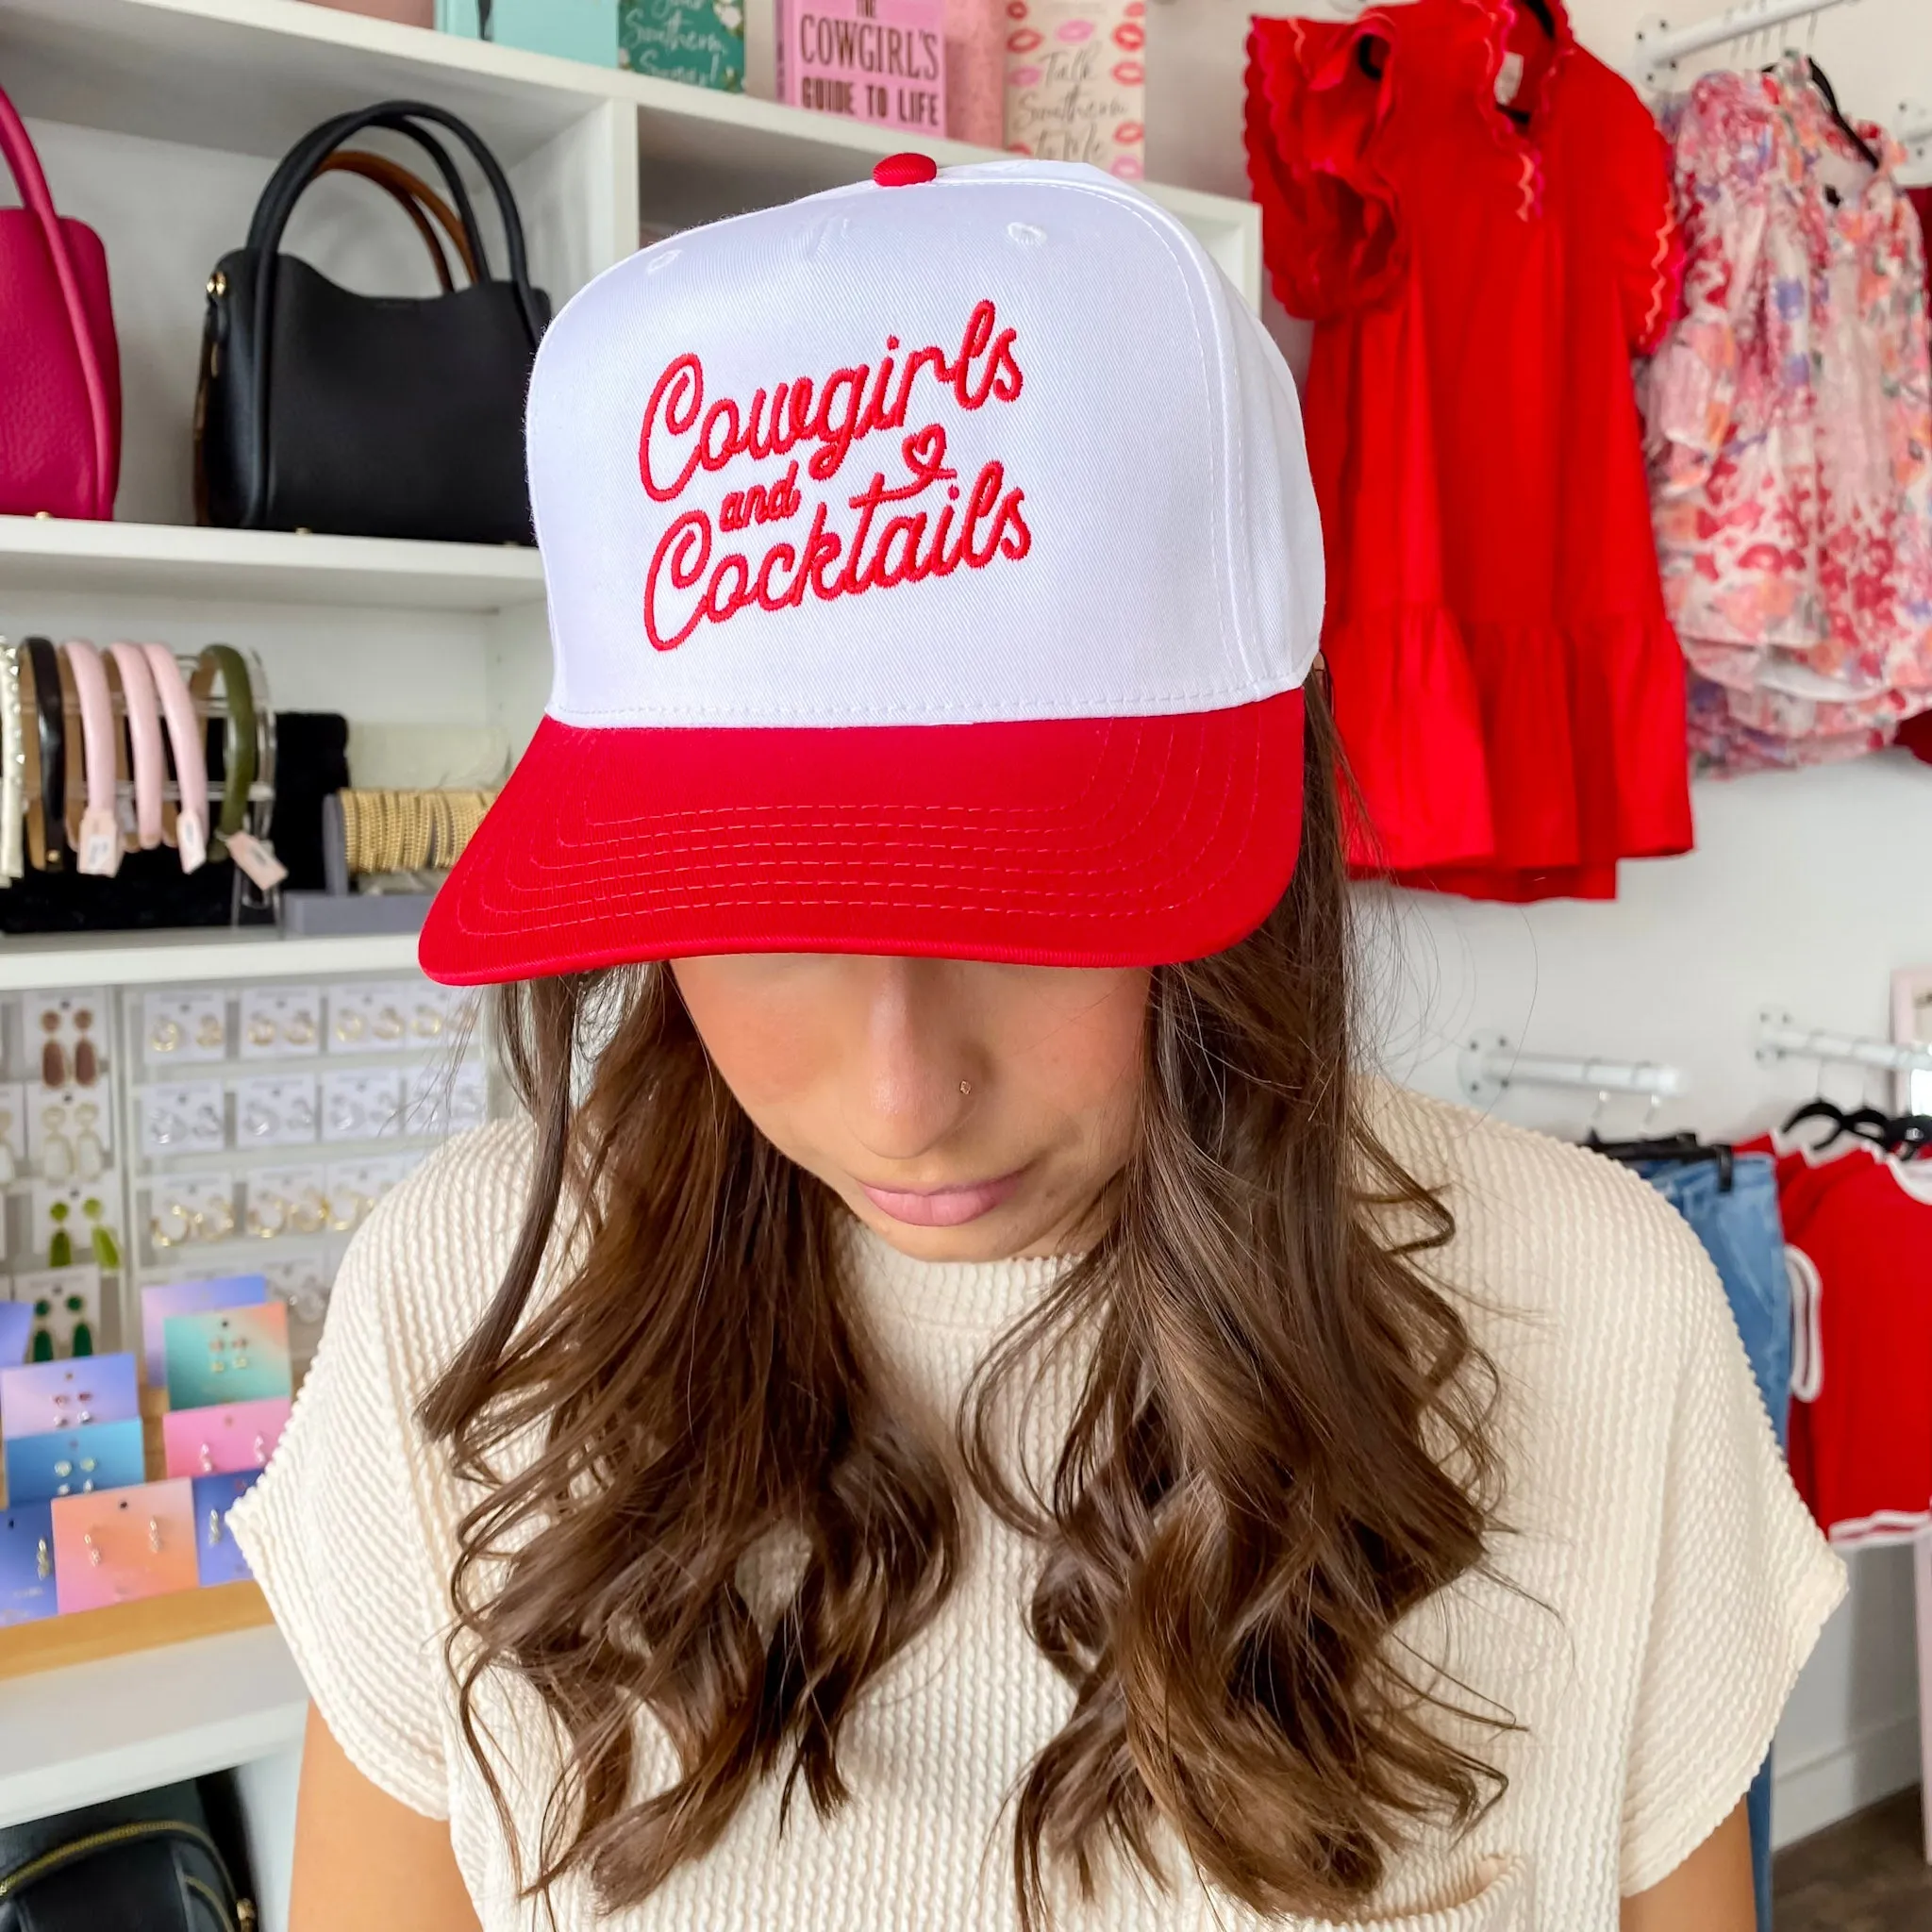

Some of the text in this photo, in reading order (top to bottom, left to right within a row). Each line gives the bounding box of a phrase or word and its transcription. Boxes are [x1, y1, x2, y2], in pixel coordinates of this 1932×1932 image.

[800, 13, 940, 81] COWGIRL'S
[802, 76, 939, 126] GUIDE TO LIFE
[639, 299, 1023, 502] Cowgirls
[719, 460, 801, 533] and
[644, 424, 1031, 651] Cocktails
